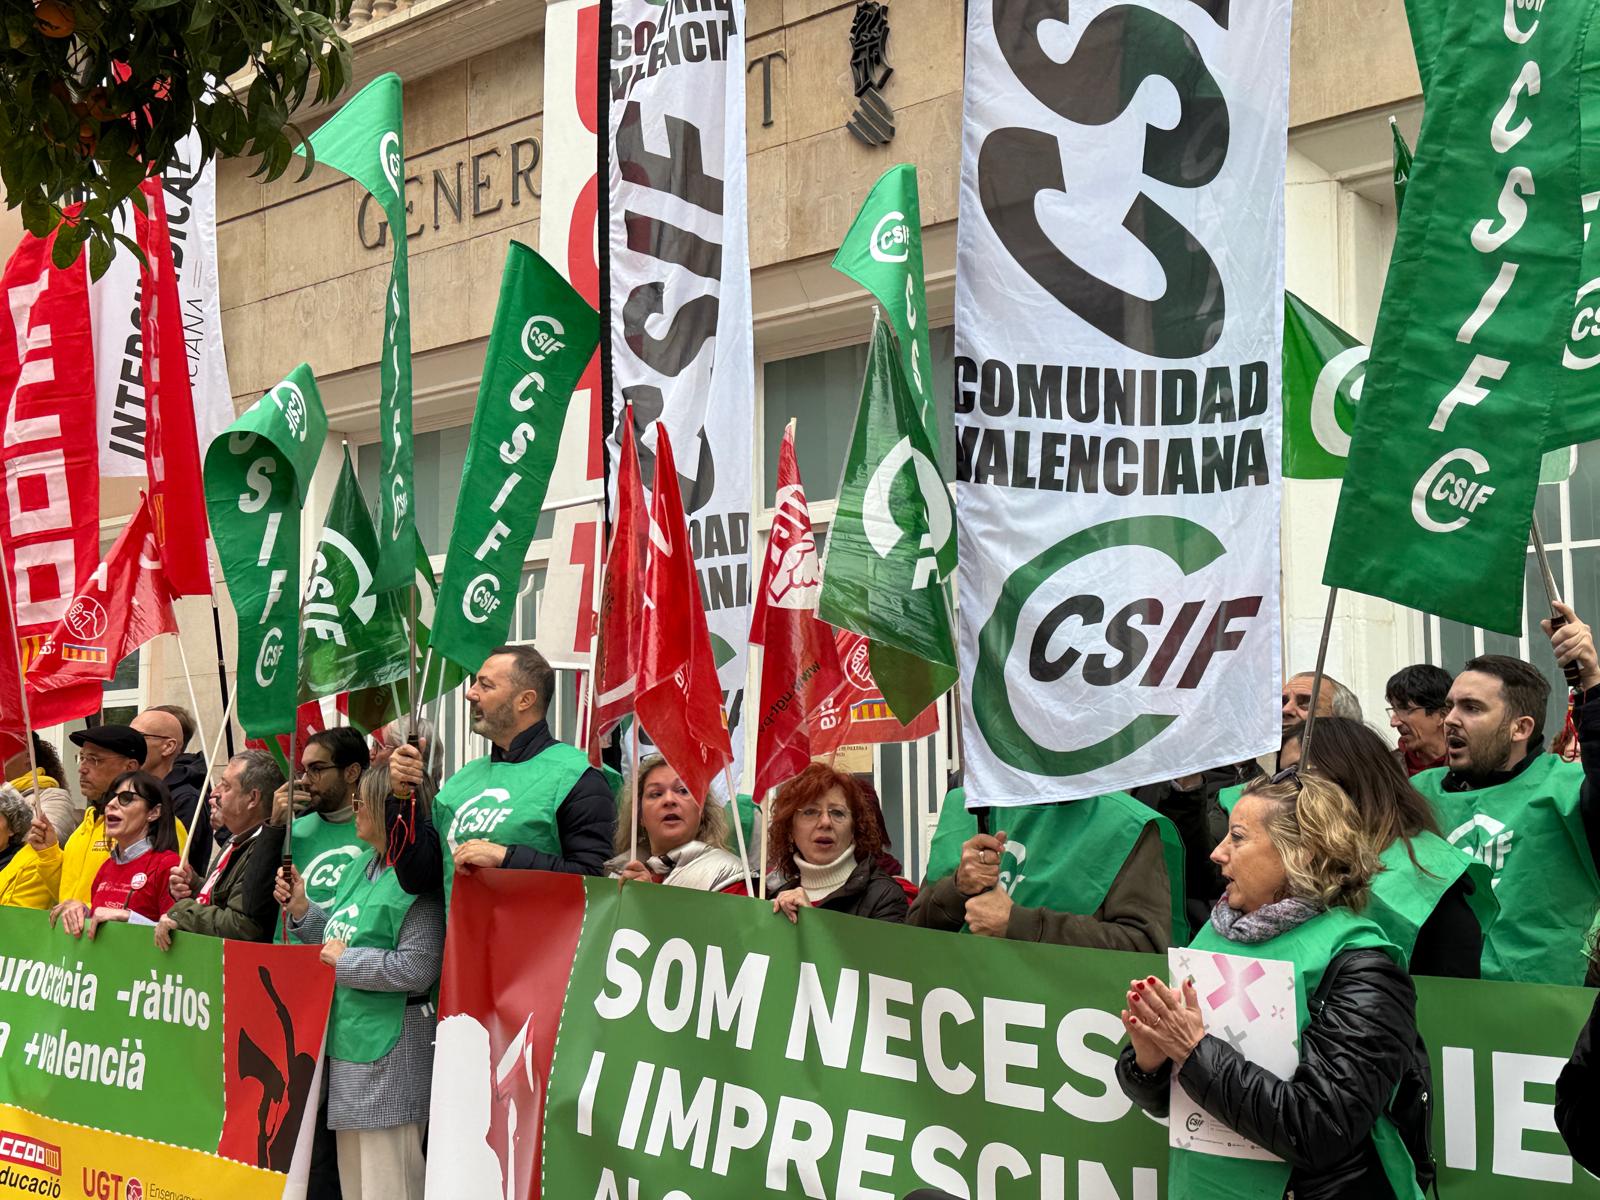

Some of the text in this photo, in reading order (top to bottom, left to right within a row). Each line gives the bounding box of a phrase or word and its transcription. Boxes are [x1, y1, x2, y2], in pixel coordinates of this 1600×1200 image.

[955, 356, 1268, 426] COMUNIDAD
[956, 425, 1269, 496] VALENCIANA
[1431, 472, 1496, 513] CSIF
[1029, 594, 1263, 689] CSIF
[459, 807, 513, 833] CSIF
[117, 969, 210, 1031] -ràtios
[594, 928, 770, 1050] SOM
[785, 962, 1140, 1124] NECES
[24, 1028, 146, 1091] +valencià
[577, 1050, 606, 1136] I
[83, 1166, 123, 1200] UGT
